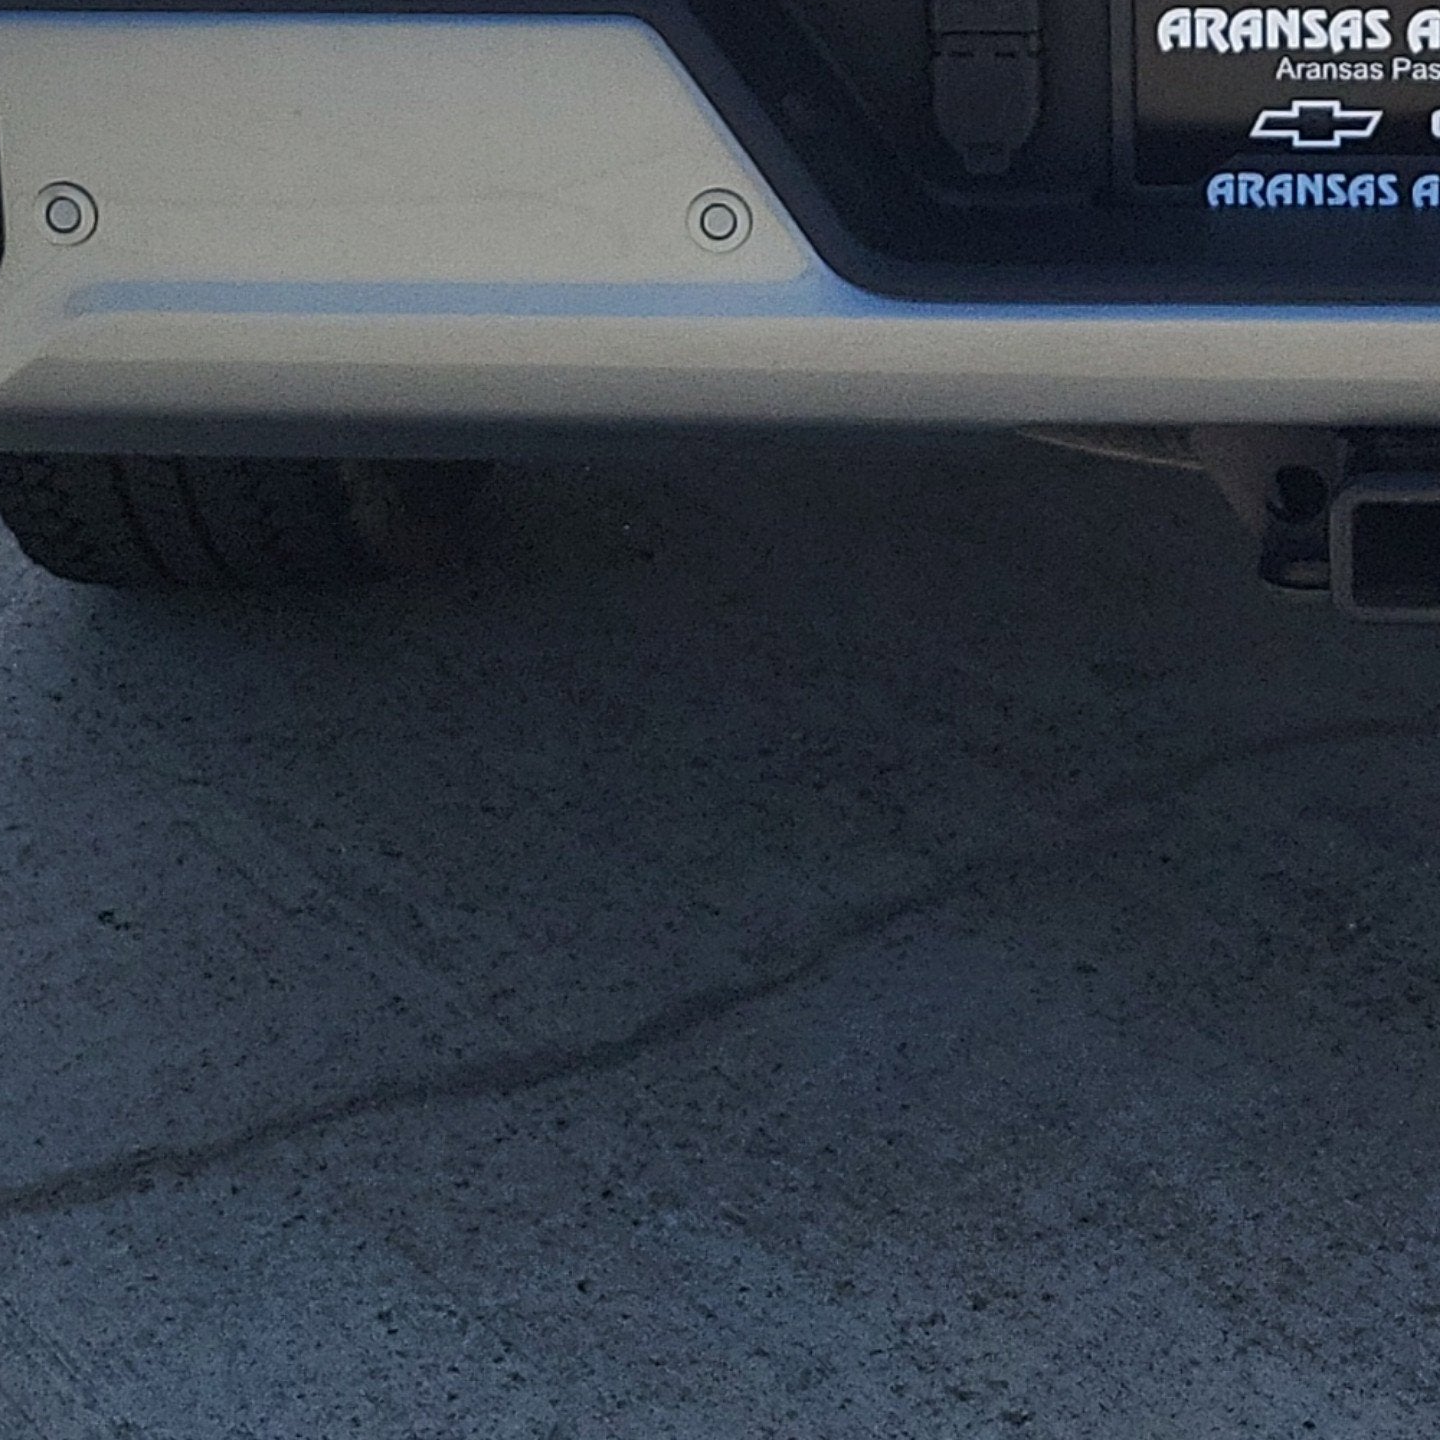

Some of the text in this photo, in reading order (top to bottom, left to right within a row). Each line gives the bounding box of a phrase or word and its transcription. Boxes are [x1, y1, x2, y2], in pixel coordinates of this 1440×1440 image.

[1157, 7, 1391, 53] ARANSAS
[1275, 57, 1384, 81] Aransas
[1206, 173, 1400, 208] ARANSAS
